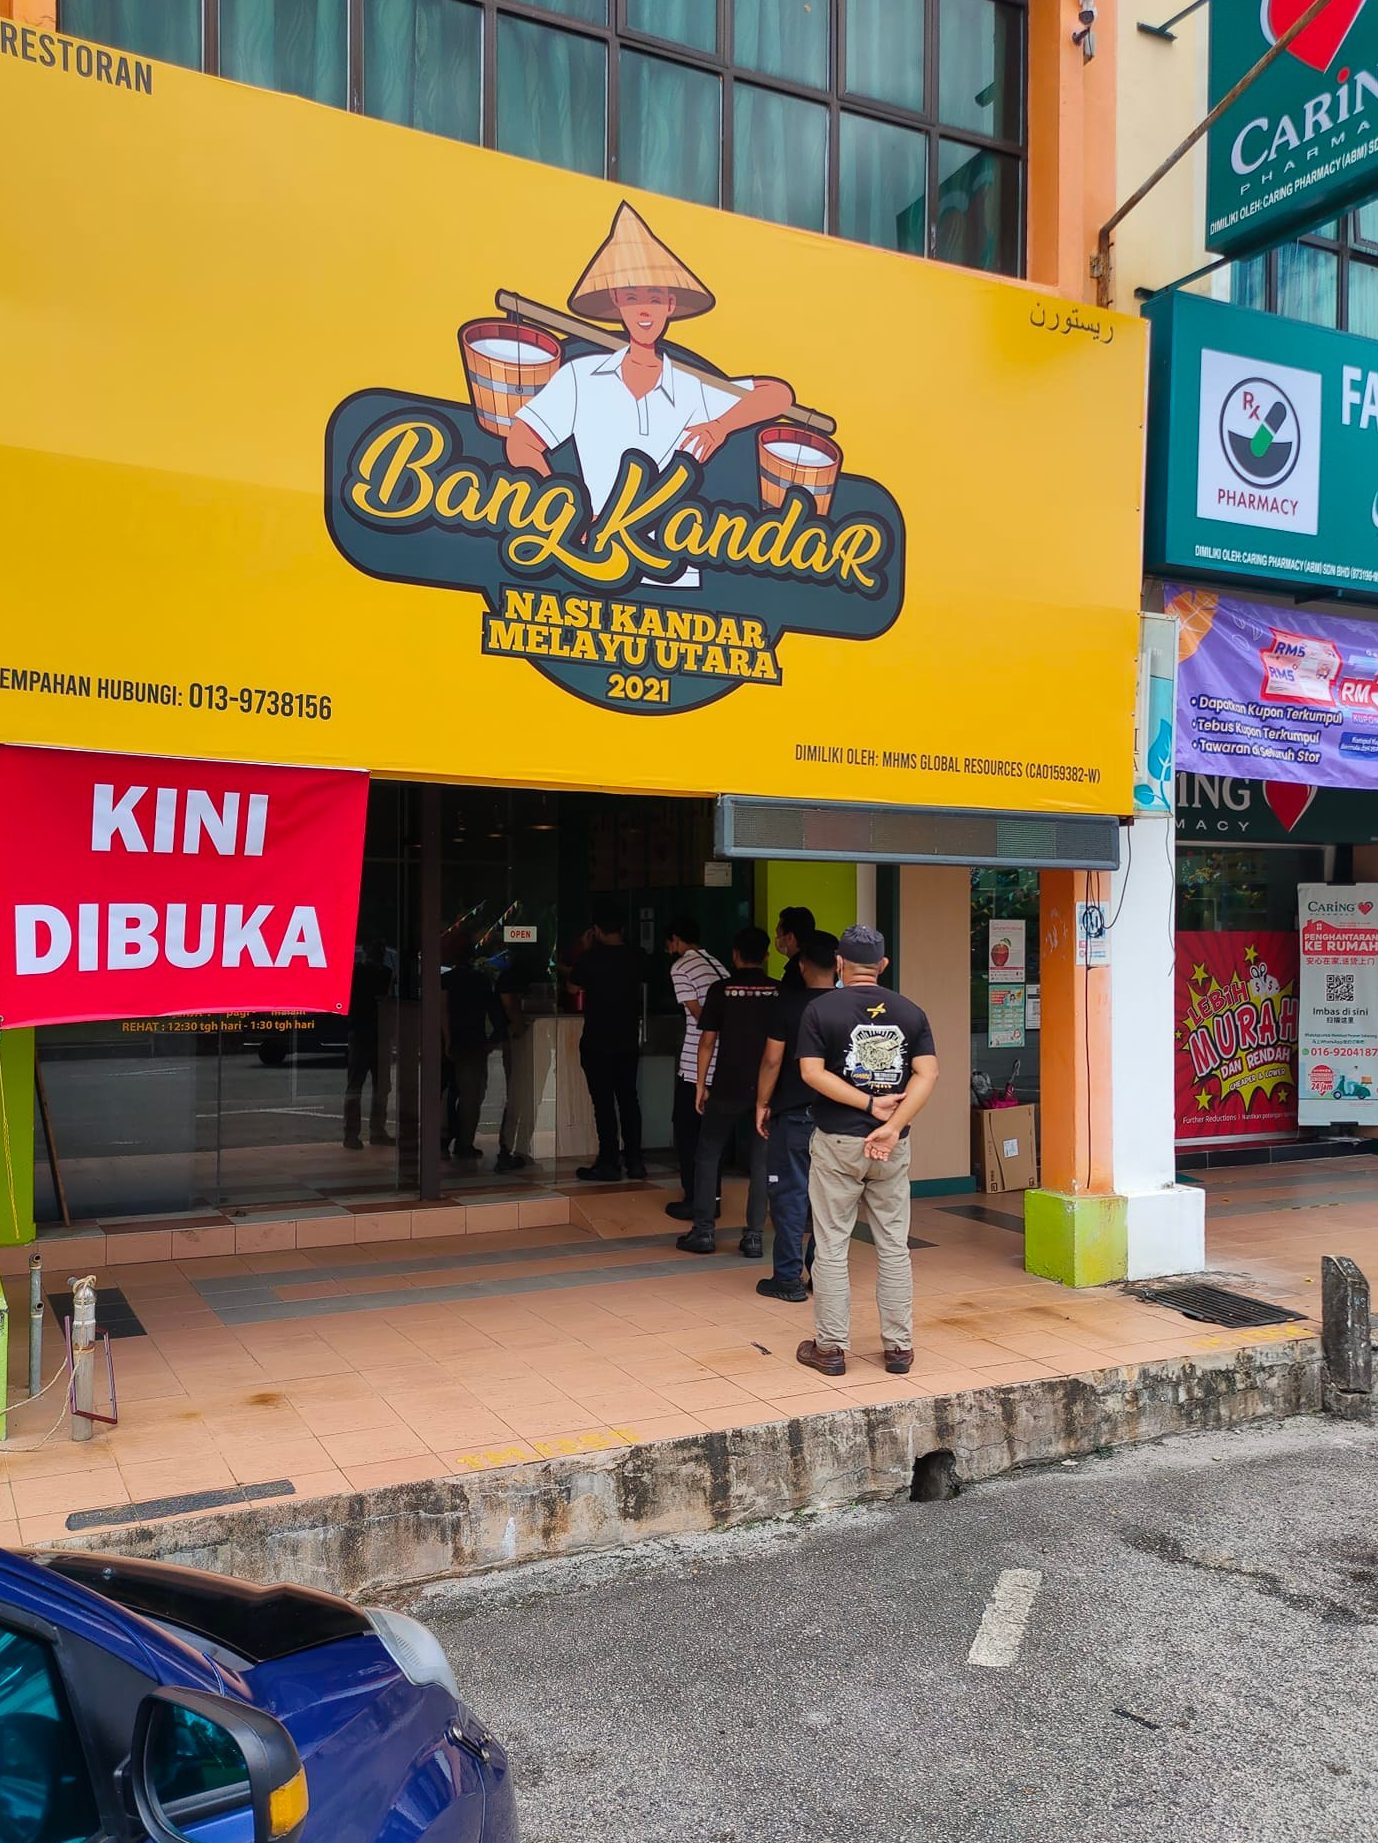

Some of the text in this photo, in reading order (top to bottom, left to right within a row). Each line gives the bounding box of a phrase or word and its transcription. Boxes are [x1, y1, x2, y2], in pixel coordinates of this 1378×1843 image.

[1, 20, 153, 95] RESTORAN
[1209, 210, 1239, 236] DIMILIKI
[1239, 198, 1263, 221] OLEH:
[1262, 181, 1294, 208] CARING
[1294, 156, 1343, 192] PHARMACY
[351, 421, 630, 581] Bang
[1217, 488, 1299, 516] PHARMACY
[1194, 544, 1222, 560] DIMILIKI
[1222, 548, 1242, 563] OLEH:
[1242, 551, 1268, 567] CARING
[1268, 555, 1305, 572] PHARMACY
[505, 590, 766, 650] NASI KANDAR
[488, 619, 778, 680] MELAYU UTARA
[1274, 641, 1306, 658] RM5
[0, 667, 333, 721] EMPAHAN HUBUNGI: 013-9738156
[607, 673, 670, 703] 2021
[1341, 682, 1372, 703] RM
[1199, 697, 1343, 726] Dapatkan Kupon Terkumpul
[1197, 719, 1320, 745] Tebus Kupon Terkumpul
[795, 743, 844, 764] DIMILIKI
[846, 748, 879, 767] OLEH:
[882, 750, 918, 770] MHMS
[919, 753, 961, 773] GLOBAL
[963, 757, 1023, 779] RESOURCES
[1200, 740, 1251, 755] Tawaran
[1296, 751, 1321, 764] Stor
[91, 783, 270, 857] KINI
[14, 903, 328, 976] DIBUKA
[510, 930, 531, 939] OPEN
[1304, 933, 1378, 941] PENGHANTARAN
[1304, 941, 1378, 952] KE RUMAH
[1312, 1007, 1369, 1016] Imbas di sini
[122, 1022, 159, 1032] REHAT
[167, 1022, 198, 1032] 12:30
[199, 1022, 218, 1033] tgh
[220, 1020, 242, 1031] hari
[250, 1020, 273, 1031] 1:30
[274, 1020, 293, 1032] tgh
[294, 1019, 315, 1030] hari
[1188, 997, 1299, 1078] MURAH
[1220, 1047, 1291, 1080] DAN RENDAH
[1311, 1047, 1378, 1057] 016-9204187
[1229, 1074, 1257, 1091] CHEAPER
[1265, 1067, 1286, 1079] LOWER
[1311, 1083, 1320, 1091] 24
[1182, 1116, 1204, 1124] Further
[1205, 1114, 1237, 1123] Reductions
